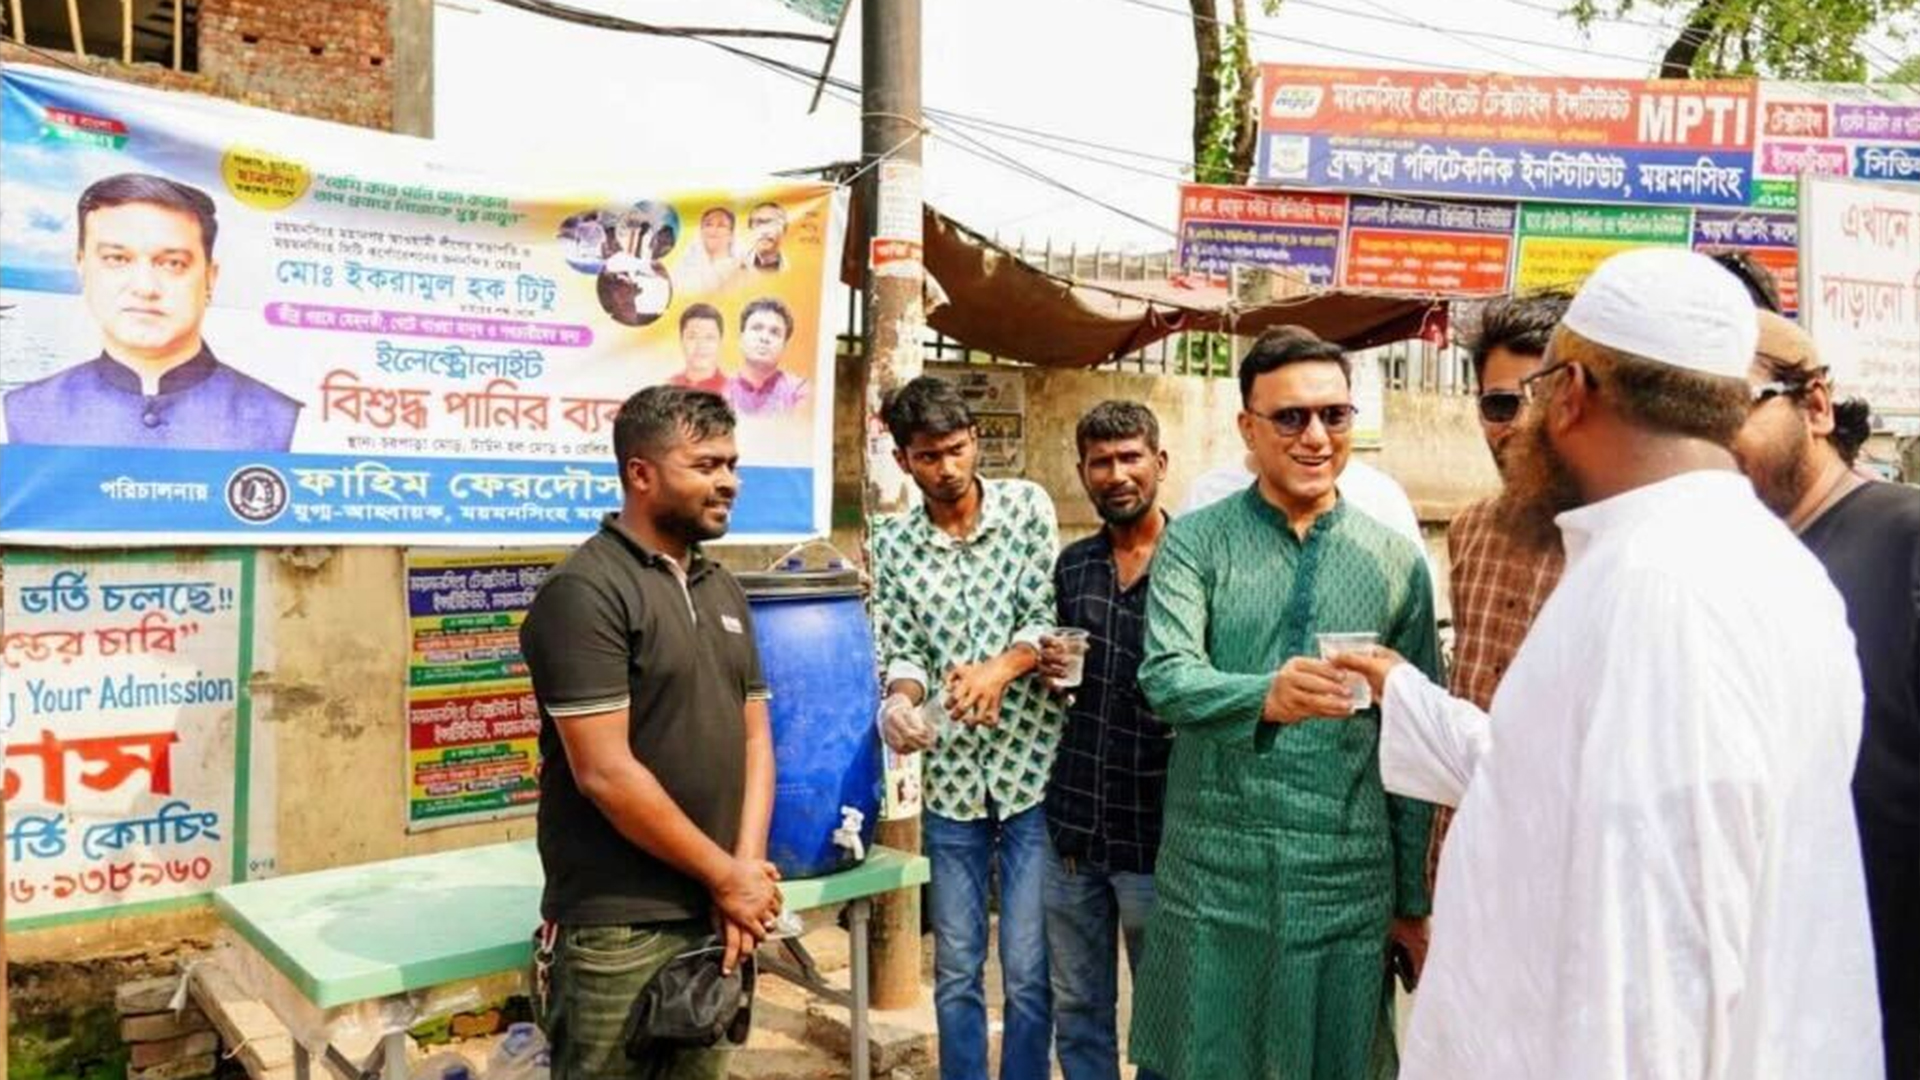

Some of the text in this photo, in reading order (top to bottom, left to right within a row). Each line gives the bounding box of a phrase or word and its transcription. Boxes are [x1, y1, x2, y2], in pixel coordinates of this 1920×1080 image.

[1637, 95, 1749, 145] MPTI
[1402, 144, 1515, 184] পলিটেকনিক
[1639, 156, 1745, 199] ময়মনসিংহ
[277, 259, 558, 312] মোঃ ইকরামুল হক টিটু
[375, 340, 546, 381] ইলেক্ট্রোলাইট
[320, 369, 432, 430] বিশুদ্ধ
[443, 379, 549, 431] পানির
[100, 475, 209, 501] পরিচালনায়
[290, 460, 430, 500] ফাহিম
[450, 465, 623, 500] ফেরদৌস
[460, 502, 569, 522] ময়মনসিংহ
[20, 571, 91, 613] ভর্তি
[27, 679, 91, 714] Your
[100, 671, 234, 710] Admission
[0, 729, 180, 806] াস
[6, 801, 221, 862] র্তি কোচিং
